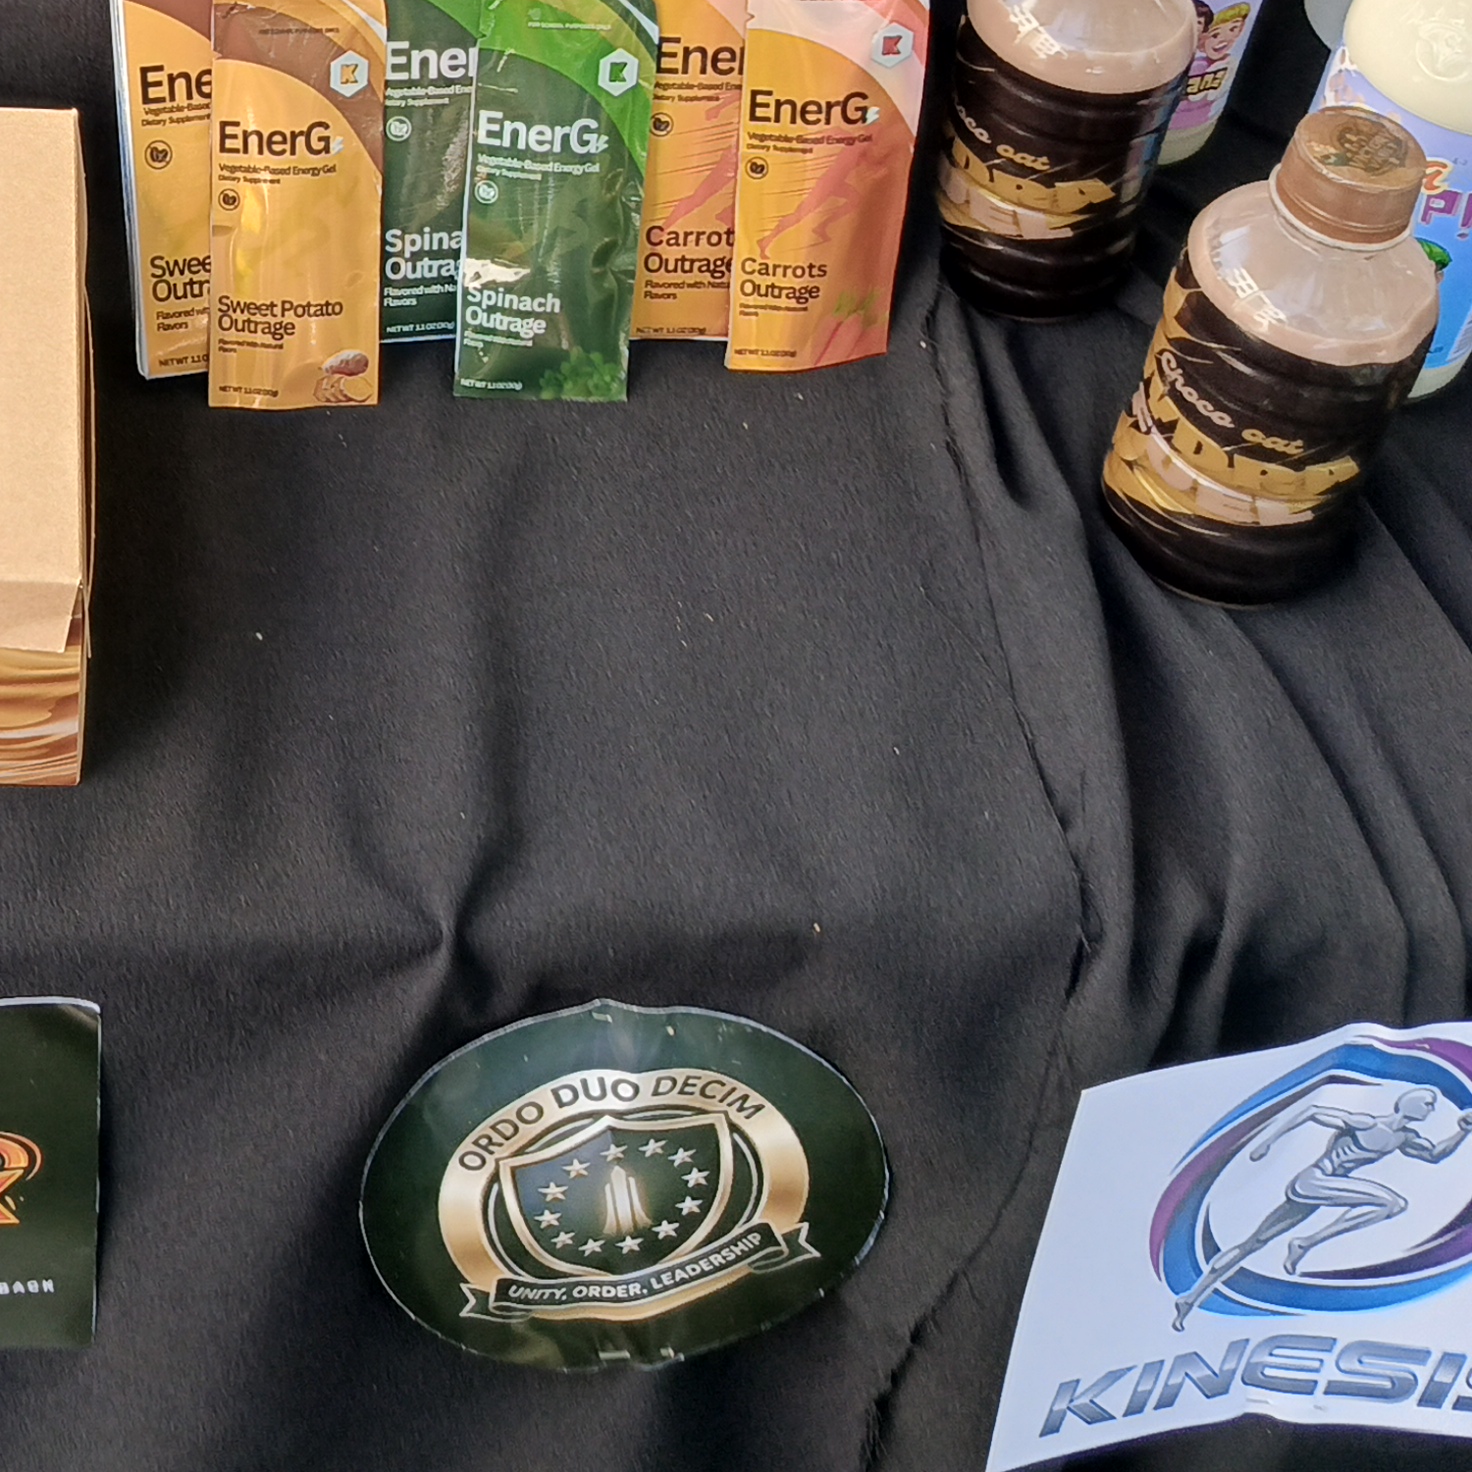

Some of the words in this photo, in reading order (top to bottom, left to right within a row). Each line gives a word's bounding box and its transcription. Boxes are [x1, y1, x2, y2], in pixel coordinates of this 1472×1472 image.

[386, 40, 476, 81] Ene
[656, 36, 745, 76] Ene
[140, 64, 212, 105] Ene
[749, 90, 869, 126] EnerG
[219, 121, 331, 156] EnerG
[478, 110, 598, 154] EnerG
[292, 166, 322, 177] Energy
[322, 164, 337, 173] Gel
[385, 227, 462, 258] Spina
[646, 225, 735, 248] Carrot
[150, 255, 211, 279] Swee
[385, 257, 460, 281] Outra
[740, 257, 828, 278] Carrots
[152, 277, 210, 302] Outr
[467, 286, 561, 313] Spinach
[644, 291, 677, 300] Flavors
[740, 279, 820, 305] Outrage
[218, 296, 278, 317] Sweet
[280, 300, 344, 319] Potato
[218, 313, 296, 341] Outrage
[466, 305, 546, 338] Outrage
[1242, 428, 1305, 454] oat
[458, 1099, 545, 1173] ORDO
[550, 1075, 640, 1111] DUO
[651, 1074, 766, 1121] DECIM
[507, 1282, 569, 1303] UNITY,
[650, 1231, 764, 1292] LEADERSHIP
